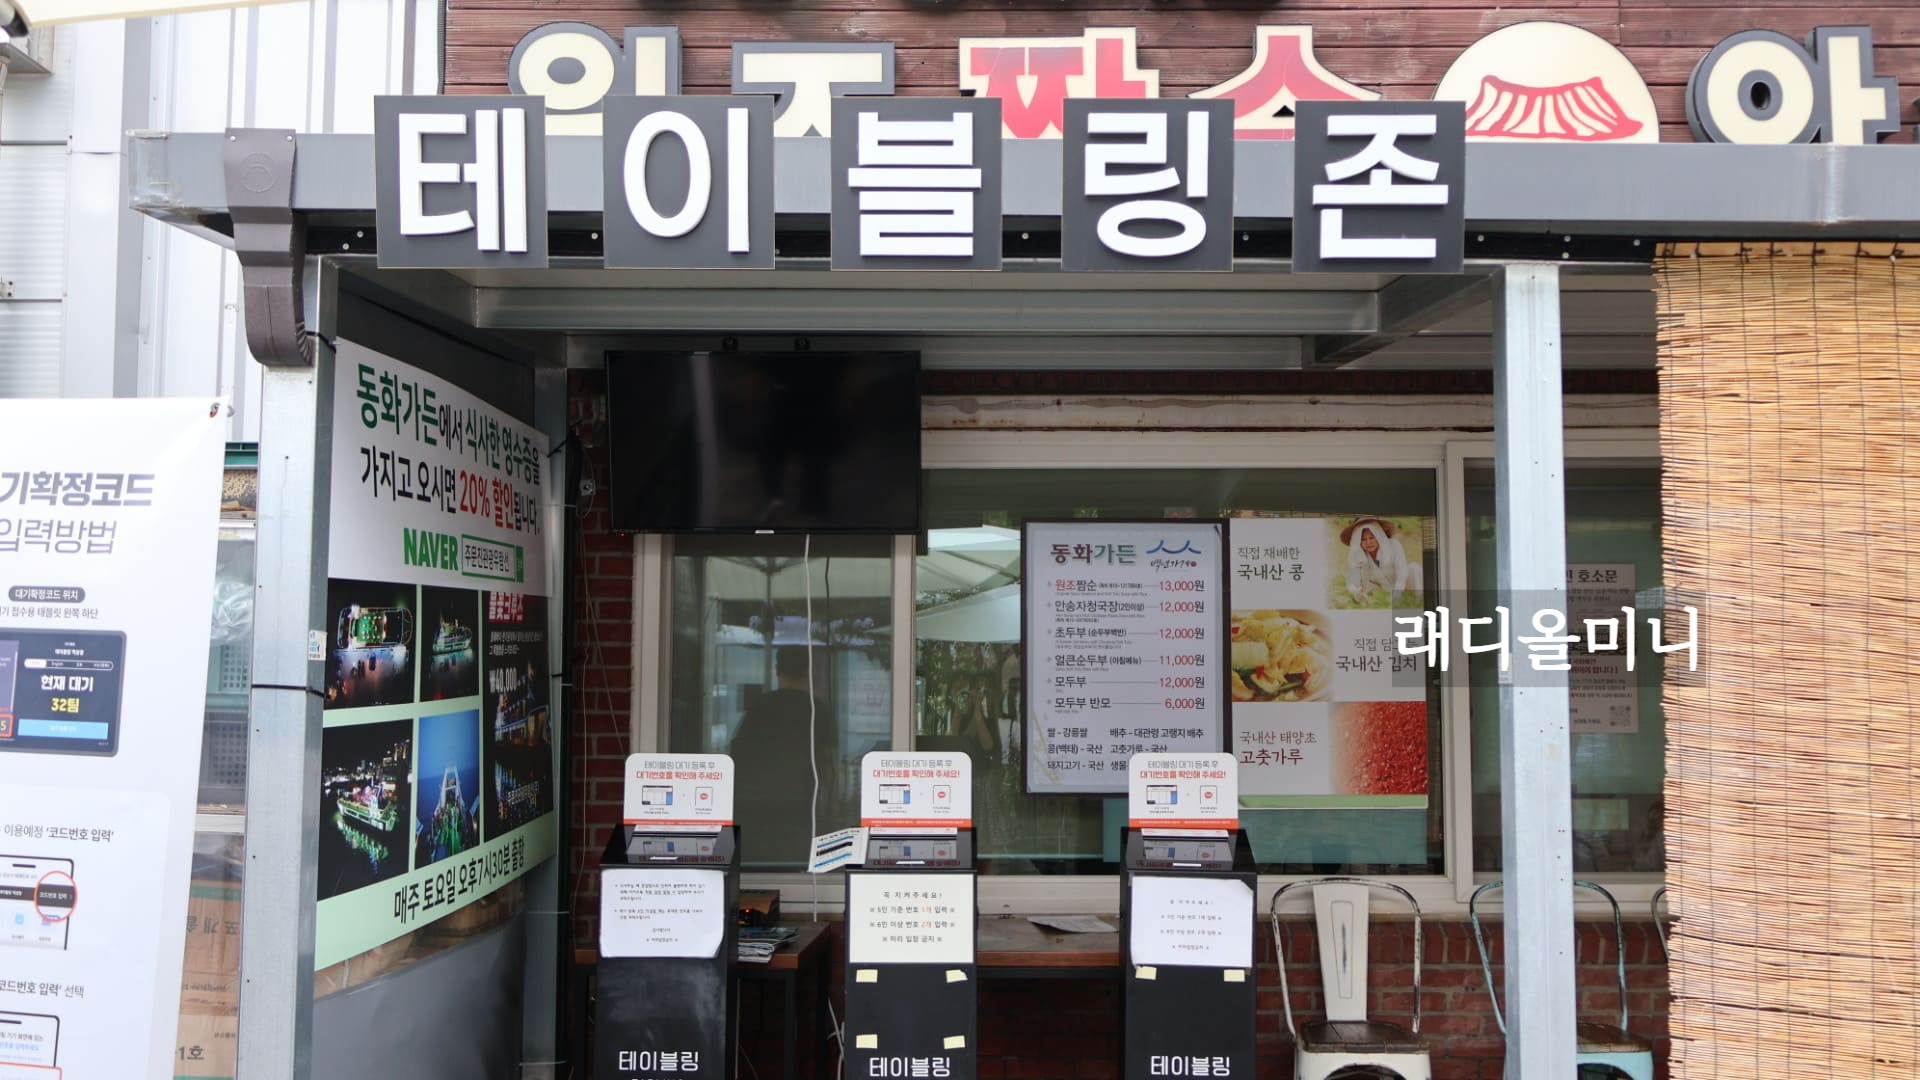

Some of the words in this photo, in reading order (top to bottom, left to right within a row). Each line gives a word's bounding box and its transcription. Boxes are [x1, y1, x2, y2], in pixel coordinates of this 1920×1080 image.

[399, 107, 1449, 260] 테이블링존
[357, 363, 463, 455] 동화가든에서
[465, 407, 500, 470] 식사한
[502, 426, 541, 486] 영수증을
[0, 471, 156, 507] 기확정코드
[459, 470, 490, 518] 20%
[492, 478, 541, 535] 할인됩니다.
[0, 518, 117, 555] 입력방법
[403, 528, 459, 571] NAVER
[1050, 543, 1137, 565] 동화가든
[1237, 546, 1260, 560] 직접
[1263, 546, 1301, 560] 재배한
[1237, 564, 1284, 581] 국내산
[1288, 564, 1304, 581] 콩
[1577, 569, 1617, 584] 호소문
[1055, 579, 1097, 592] 원조짬순
[1159, 580, 1205, 593] 13,000원
[81, 608, 99, 619] 하단
[1159, 601, 1205, 614] 12,000원
[1055, 627, 1087, 639] 초두부
[1159, 627, 1205, 640] 12,000원
[1353, 638, 1376, 652] 직접
[1054, 654, 1107, 667] 얼큰순두부
[1159, 654, 1205, 667] 11,000원
[1336, 656, 1383, 672] 국내산
[1388, 656, 1417, 672] 김치
[41, 674, 66, 691] 현재
[68, 676, 94, 692] 대기
[1054, 676, 1087, 688] 모두부
[1159, 676, 1205, 689] 12,000원
[50, 697, 80, 713] 32팀
[1054, 697, 1087, 709] 모두부
[1089, 697, 1112, 709] 반모
[1164, 697, 1205, 710] 6,000원
[1047, 728, 1056, 738] 쌀
[1062, 728, 1088, 738] 강릉쌀
[1110, 728, 1127, 738] 배추
[1134, 728, 1161, 739] 대관령
[1161, 728, 1186, 739] 고랭지
[1187, 728, 1204, 738] 배추
[1239, 731, 1276, 744] 국내산
[1280, 731, 1317, 744] 태양초
[1086, 744, 1103, 755] 국산
[1110, 744, 1144, 755] 고춧가루
[1150, 744, 1168, 754] 국산
[645, 761, 674, 769] 테이블링
[675, 761, 690, 769] 대기
[881, 760, 910, 768] 테이블링
[912, 760, 927, 768] 대기
[1147, 760, 1177, 769] 테이블링
[1179, 760, 1194, 769] 대기
[1239, 749, 1304, 767] 고춧가루
[1047, 760, 1081, 771] 돼지고기
[1087, 760, 1104, 772] 국산
[636, 770, 673, 780] 대기번호를
[698, 770, 722, 780] 주세요!
[873, 769, 910, 778] 대기번호를
[936, 769, 960, 778] 주세요!
[1140, 770, 1177, 779] 대기번호를
[1201, 770, 1226, 779] 주세요!
[4, 823, 44, 838] 이용예정
[394, 882, 420, 924] 매주
[422, 865, 456, 911] 토요일
[618, 1051, 699, 1072] 테이블링
[869, 1057, 951, 1077] 테이블링
[1150, 1056, 1231, 1077] 테이블링
